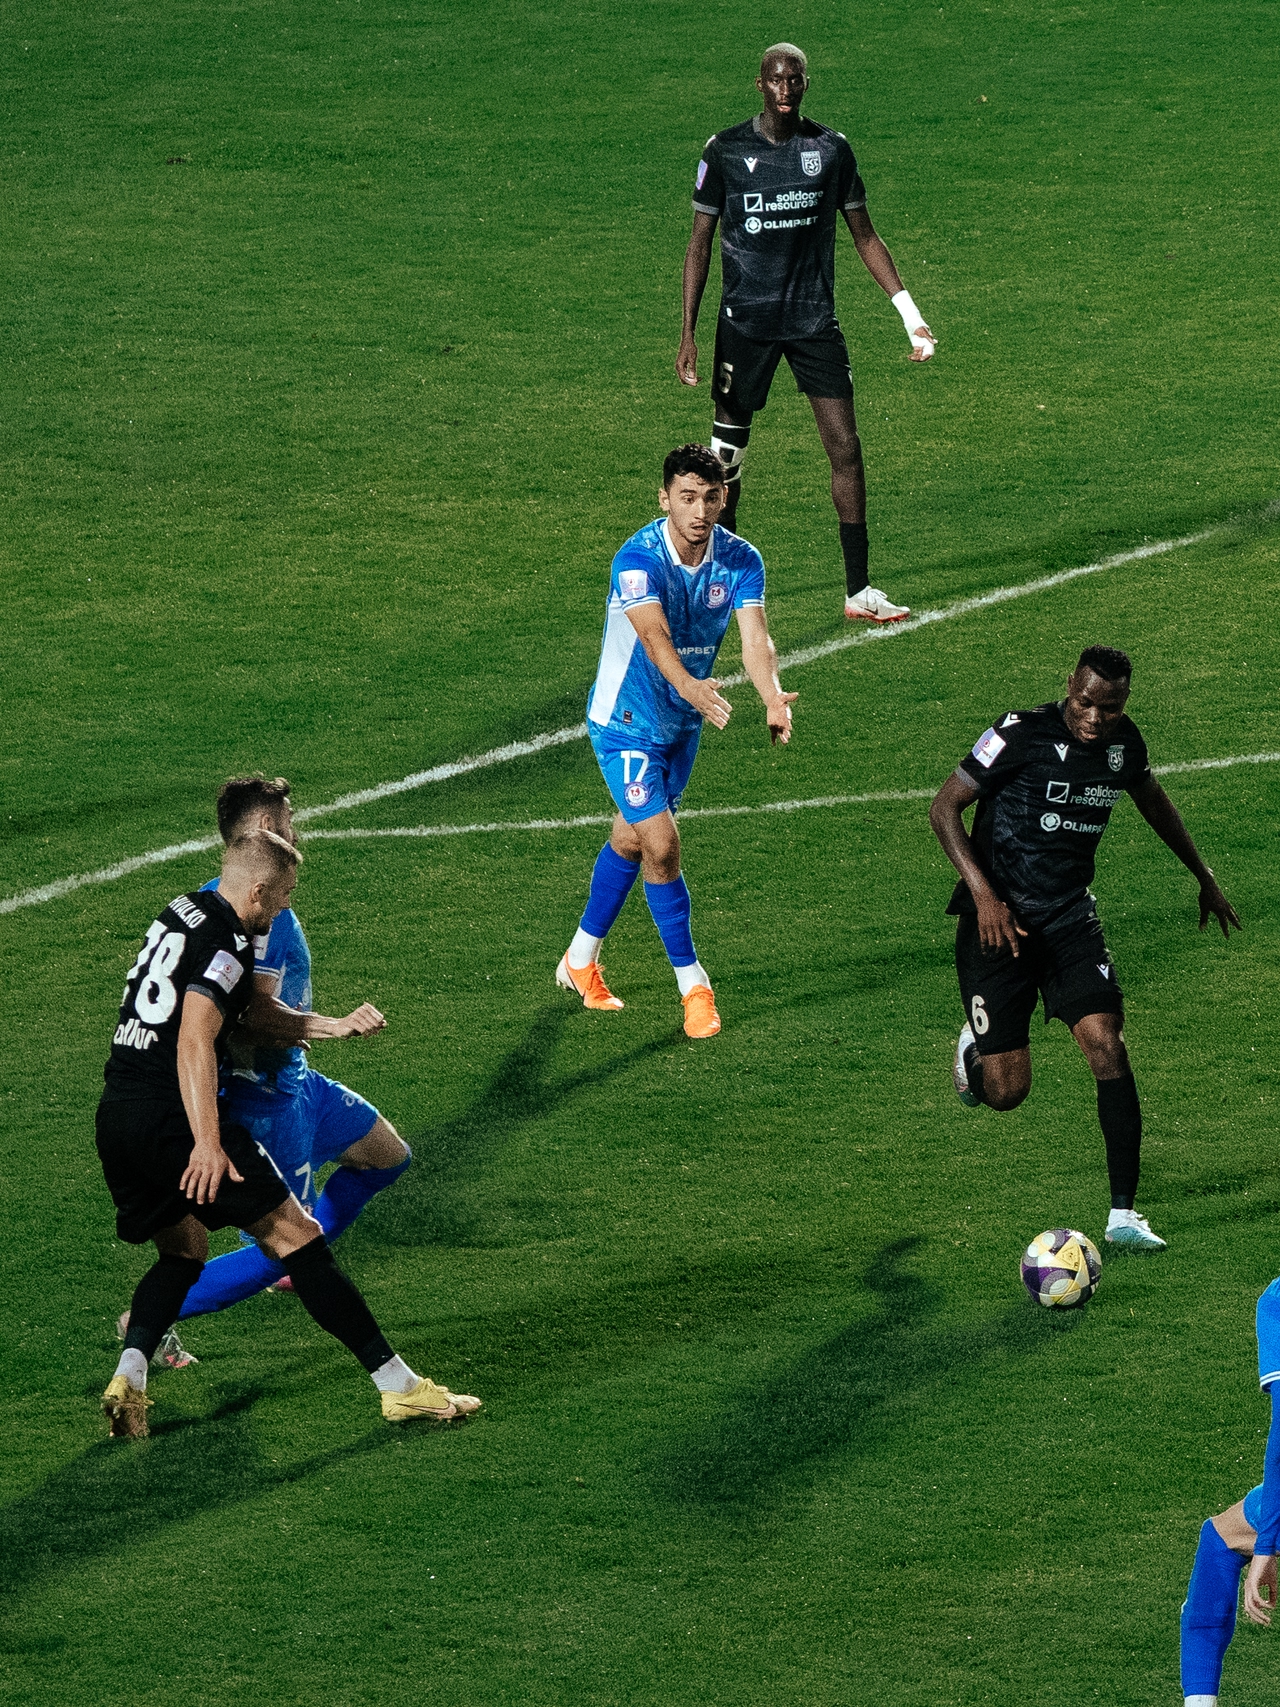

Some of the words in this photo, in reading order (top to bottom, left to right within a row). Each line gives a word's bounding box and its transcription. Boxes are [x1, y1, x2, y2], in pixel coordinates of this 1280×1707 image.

[765, 199, 818, 212] resources
[776, 190, 824, 203] solidcore
[763, 216, 819, 229] OLIMPBET
[718, 361, 734, 394] 5
[620, 750, 649, 784] 17
[971, 995, 990, 1035] 6
[113, 1018, 159, 1050] allur
[294, 1161, 312, 1200] 7
